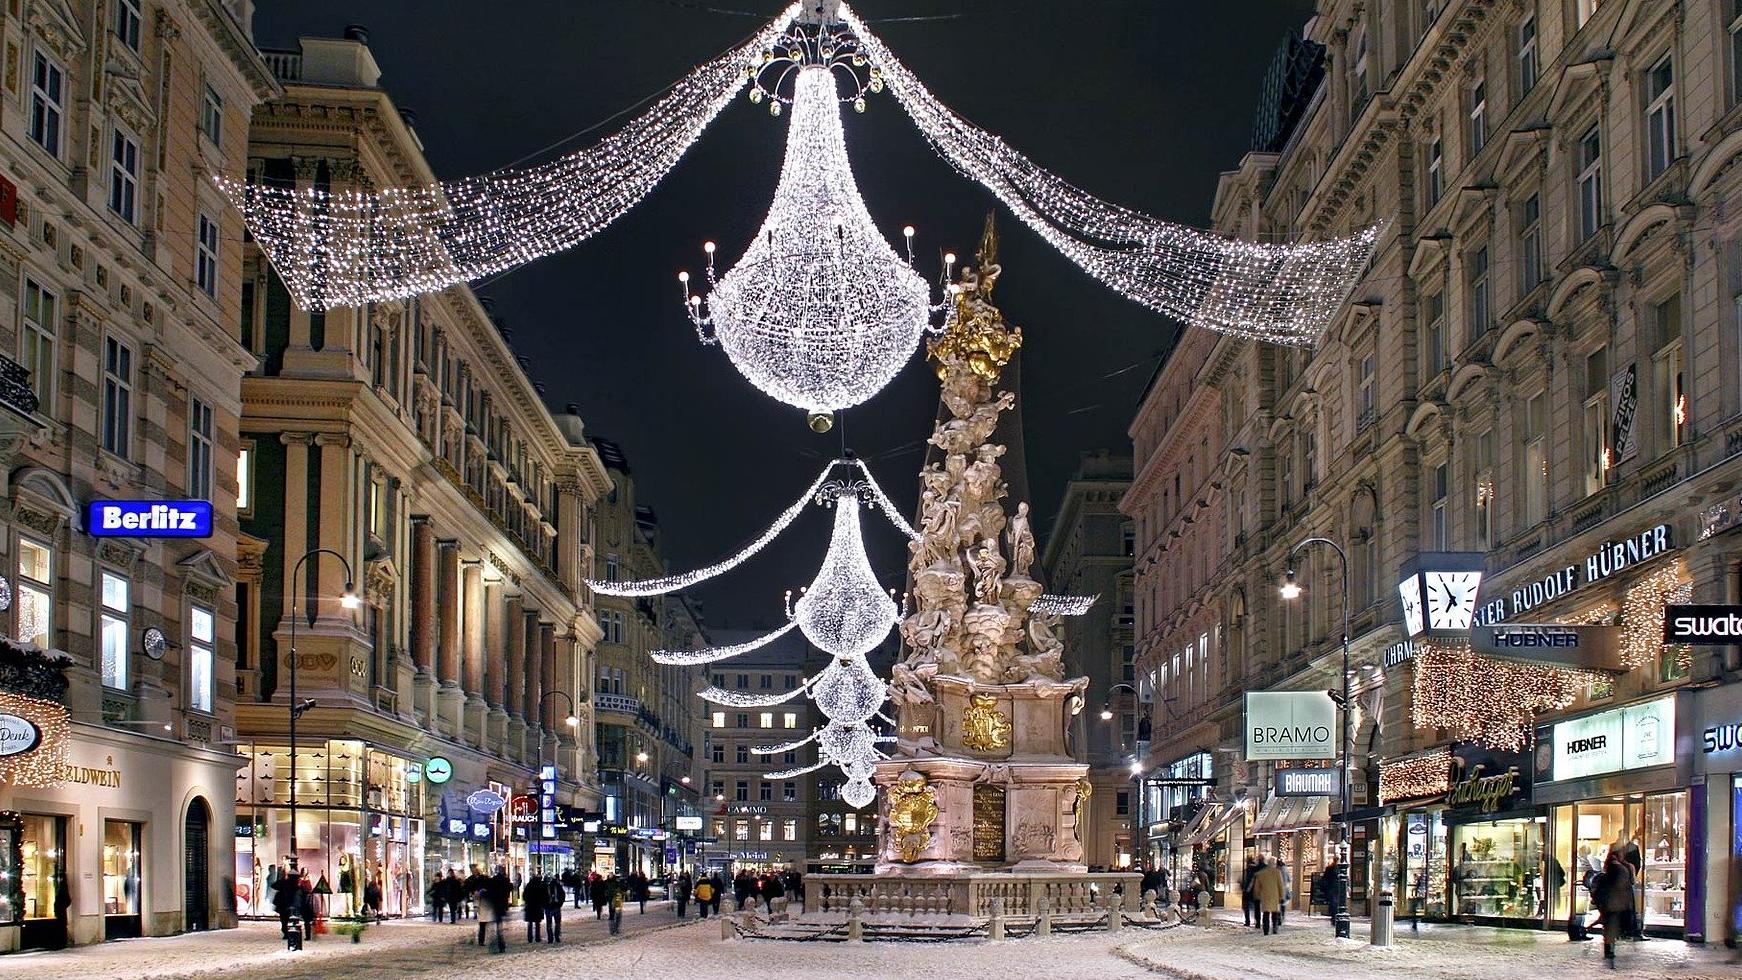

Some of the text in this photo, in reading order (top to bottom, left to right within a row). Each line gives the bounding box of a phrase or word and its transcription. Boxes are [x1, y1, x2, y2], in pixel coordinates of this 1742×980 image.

[1615, 371, 1635, 429] ZIKOS
[1616, 395, 1637, 455] PELZE
[103, 504, 197, 530] Berlitz
[1513, 565, 1577, 614] RUDOLF
[1587, 524, 1668, 582] HÜBNER
[1253, 726, 1330, 743] BRAMO
